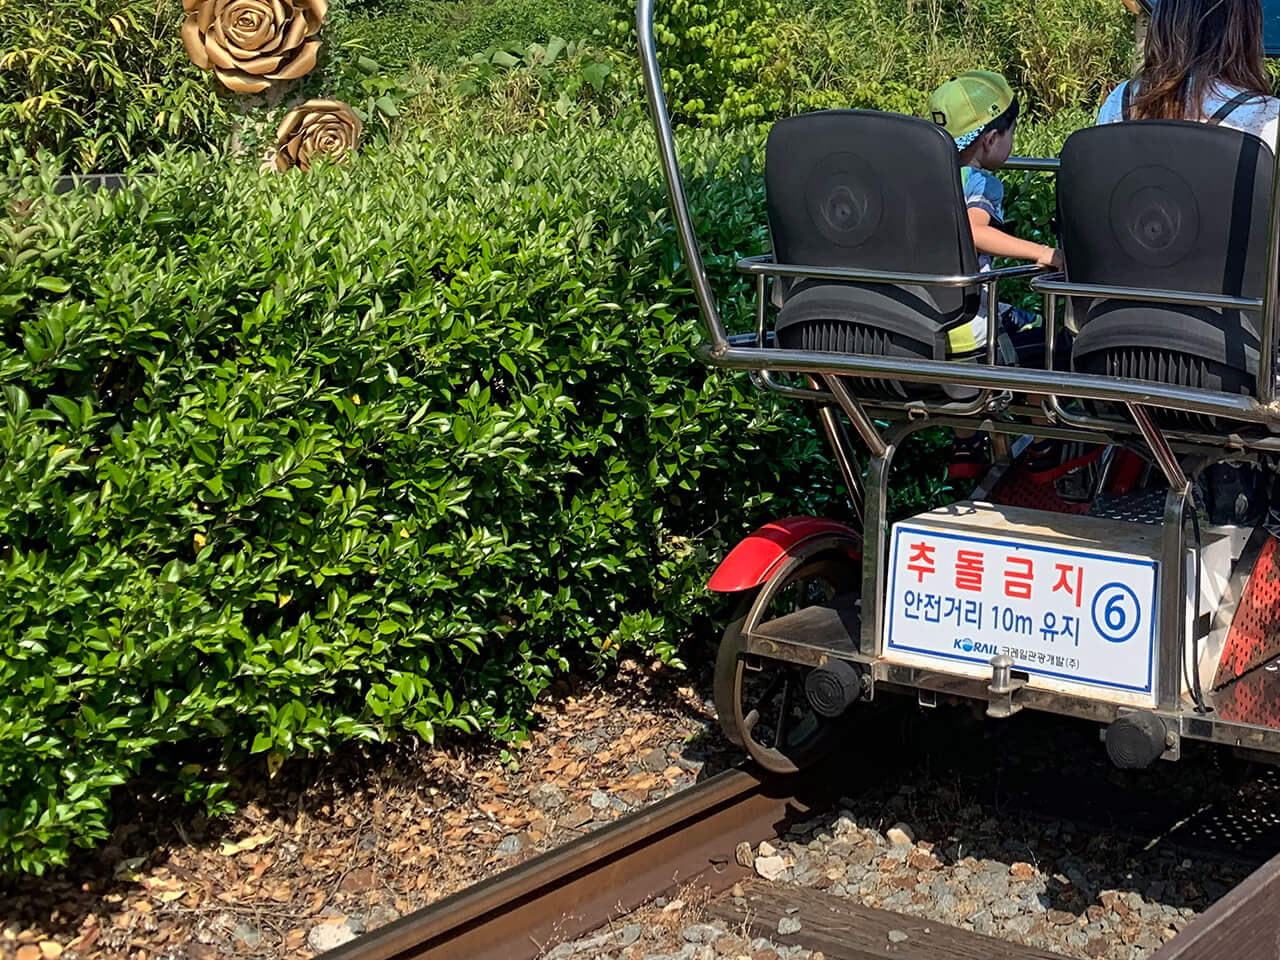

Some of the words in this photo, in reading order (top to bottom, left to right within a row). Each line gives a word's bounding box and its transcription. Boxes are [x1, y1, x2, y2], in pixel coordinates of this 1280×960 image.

[903, 589, 983, 631] 안전거리
[991, 605, 1033, 636] 10m
[1039, 611, 1081, 647] 유지
[953, 637, 999, 656] KORAIL
